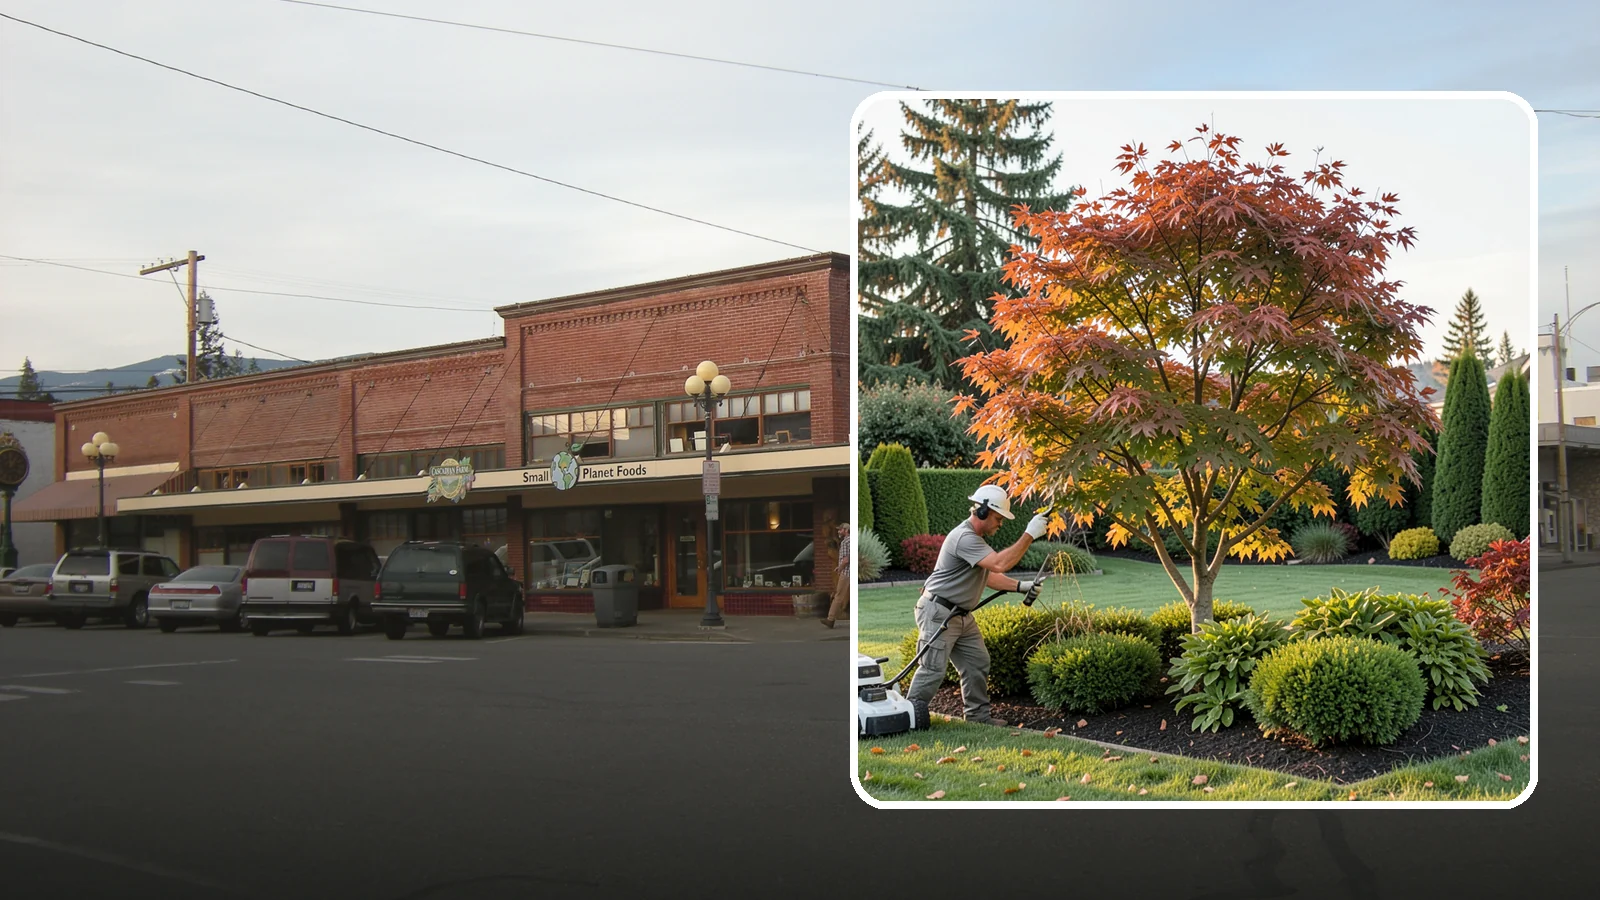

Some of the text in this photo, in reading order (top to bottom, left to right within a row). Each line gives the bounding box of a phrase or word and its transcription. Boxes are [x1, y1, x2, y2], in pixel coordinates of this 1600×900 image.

[523, 464, 647, 483] Small Planet Foods
